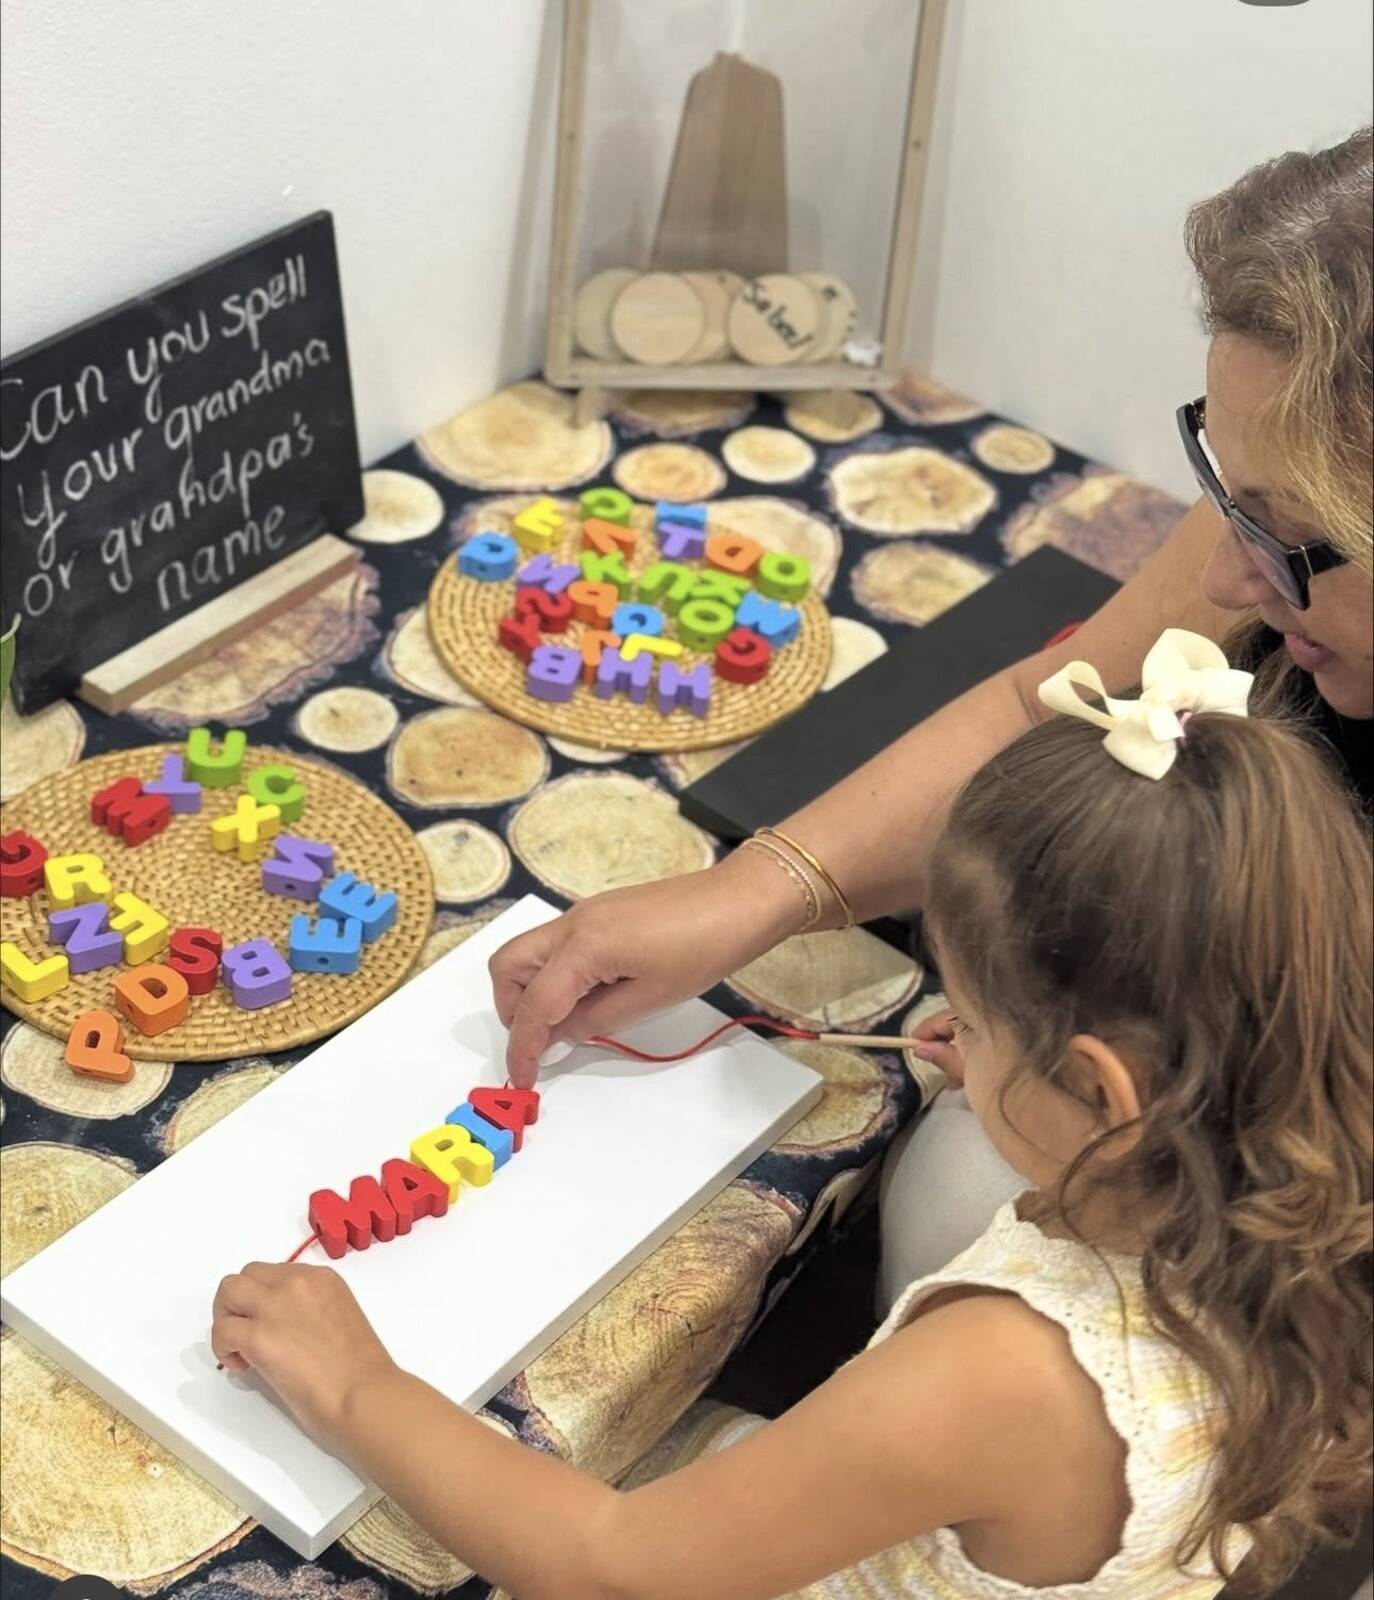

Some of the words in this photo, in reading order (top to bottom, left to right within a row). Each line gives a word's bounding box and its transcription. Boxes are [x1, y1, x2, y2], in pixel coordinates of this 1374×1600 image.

[0, 364, 109, 461] Can
[126, 310, 210, 425] you
[220, 253, 307, 351] spell
[17, 427, 143, 571] your
[163, 338, 331, 495] grandma
[24, 551, 79, 617] or
[101, 411, 315, 594] grandpa's
[156, 505, 286, 612] name
[187, 728, 247, 781] U
[211, 795, 281, 855] X
[45, 854, 112, 906] R
[170, 926, 222, 989] S
[290, 914, 362, 968] E
[115, 963, 189, 1030] D
[65, 1008, 134, 1080] P
[308, 1087, 540, 1257] MARIA
